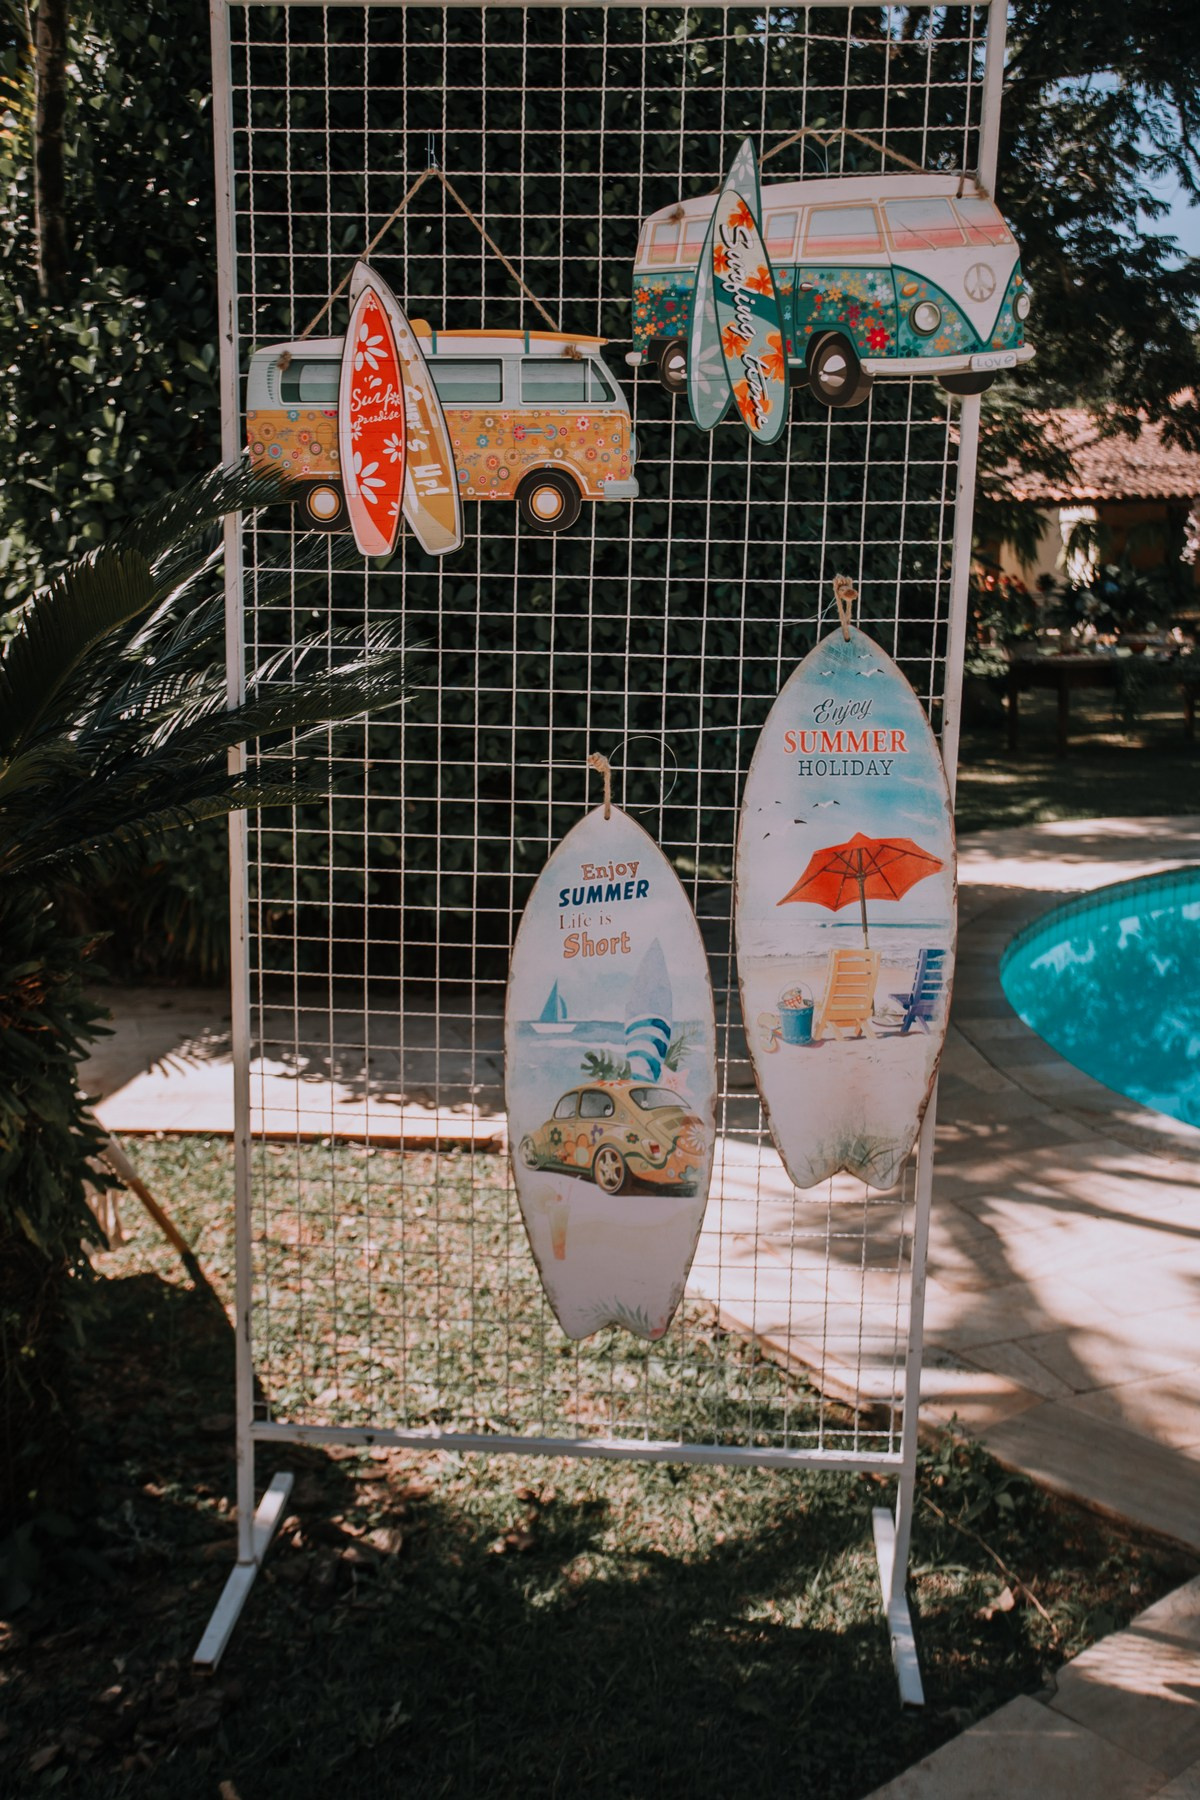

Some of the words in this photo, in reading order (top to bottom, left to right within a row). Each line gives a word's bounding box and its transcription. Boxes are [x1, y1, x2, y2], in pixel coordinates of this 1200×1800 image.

[719, 224, 759, 342] Surfing
[741, 353, 773, 430] time
[351, 384, 393, 412] Surf
[813, 698, 873, 725] Enjoy
[784, 730, 908, 754] SUMMER
[798, 760, 893, 776] HOLIDAY
[581, 861, 639, 881] Enjoy
[559, 880, 649, 907] SUMMER
[560, 912, 592, 929] Life
[600, 910, 612, 925] is
[563, 931, 631, 958] Short
